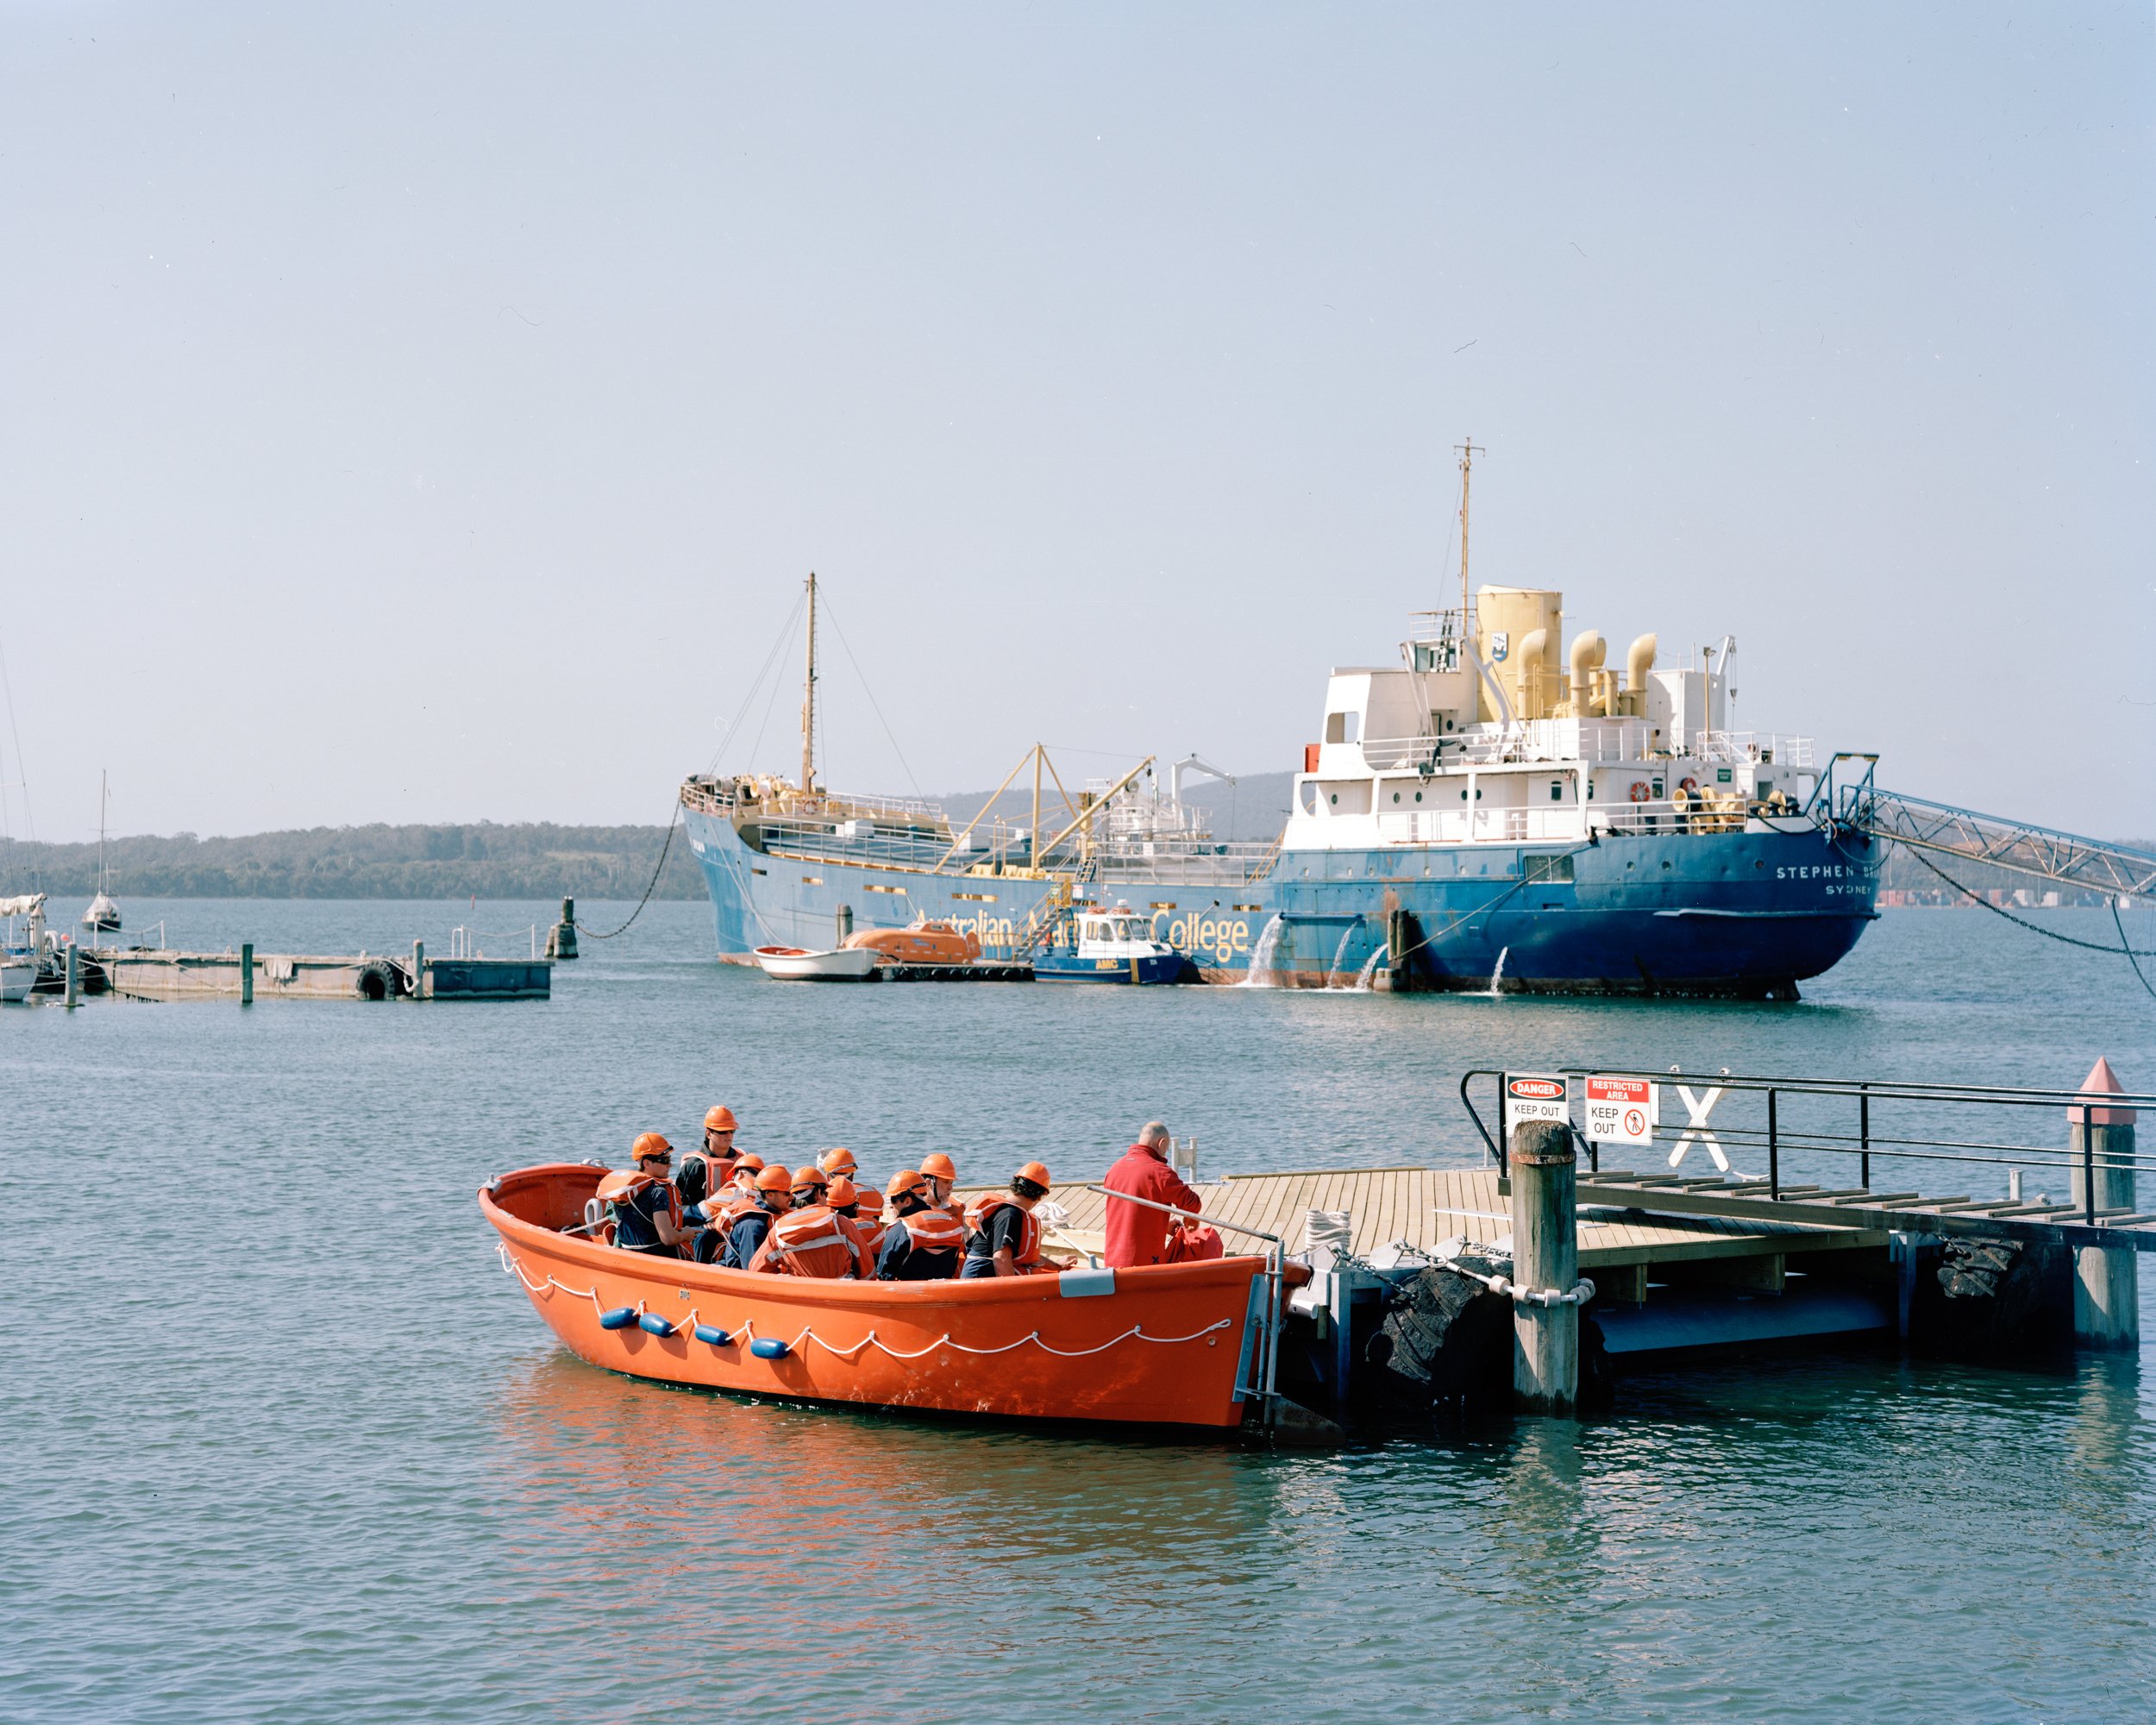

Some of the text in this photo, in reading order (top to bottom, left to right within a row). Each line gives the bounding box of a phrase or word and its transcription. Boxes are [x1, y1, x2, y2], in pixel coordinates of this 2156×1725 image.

[1777, 865, 1854, 879] STEPHEN
[1826, 885, 1871, 895] SYDNEY
[1150, 909, 1249, 963] College
[1096, 959, 1119, 970] AMC
[1516, 1082, 1557, 1095] DANGER
[1592, 1080, 1643, 1092] RESTRICTED
[1606, 1090, 1629, 1101] AREA
[1514, 1104, 1560, 1117] KEEP OUT
[1591, 1107, 1619, 1119] KEEP
[1594, 1122, 1616, 1134] OUT
